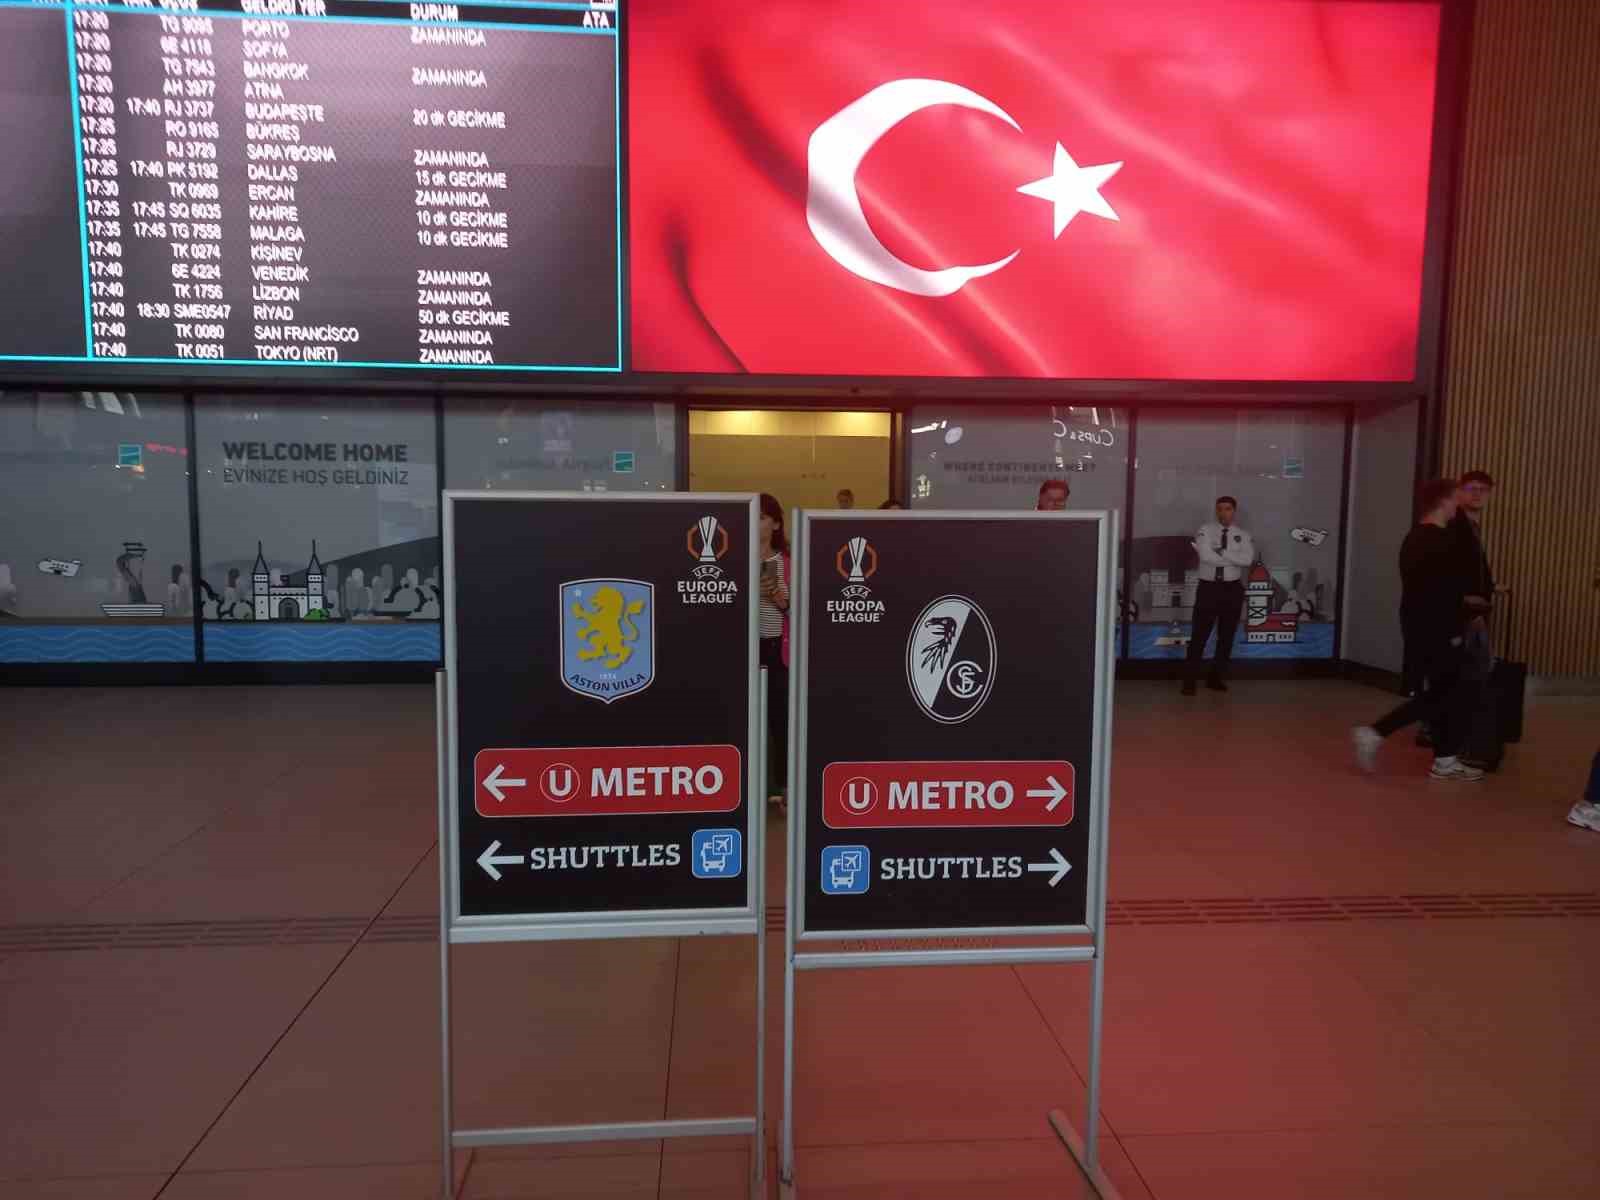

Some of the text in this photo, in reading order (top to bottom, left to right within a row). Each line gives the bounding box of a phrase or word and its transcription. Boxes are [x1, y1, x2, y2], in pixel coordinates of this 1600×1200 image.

[410, 3, 458, 22] DURUM
[583, 11, 610, 28] ATA
[241, 20, 290, 38] PORTO
[411, 27, 486, 46] ZAMANINDA
[242, 40, 289, 59] SOFYA
[243, 60, 310, 81] BANGKOK
[412, 67, 487, 88] ZAMANINDA
[163, 78, 183, 96] AH
[126, 98, 161, 116] 17:40
[164, 99, 182, 117] RJ
[184, 100, 214, 118] 3737
[413, 109, 428, 126] 20
[165, 120, 187, 137] RO
[246, 122, 300, 143] BÜKREŞ
[166, 141, 184, 158] RJ
[247, 144, 336, 162] SARAYBOSNA
[414, 149, 489, 167] ZAMANINDA
[130, 160, 163, 178] 17:40
[167, 161, 187, 178] PK
[248, 164, 298, 181] DALLAS
[416, 171, 430, 187] 15
[432, 172, 447, 188] dk
[85, 179, 119, 196] 17:30
[168, 182, 188, 199] TK
[248, 184, 294, 201] ERCAN
[415, 190, 489, 207] ZAMANINDA
[86, 200, 120, 217] 17:35
[132, 202, 165, 218] 17:45
[169, 202, 190, 219] SQ
[249, 203, 298, 222] KAHİRE
[417, 210, 430, 226] 10
[433, 211, 447, 227] dk
[88, 220, 121, 237] 17:35
[133, 222, 167, 238] 17:45
[170, 223, 190, 239] TG
[250, 226, 305, 242] MALAGA
[417, 230, 430, 246] 10
[433, 231, 448, 247] dk
[89, 241, 122, 257] 17:40
[171, 243, 190, 259] TK
[191, 244, 221, 259] 0274
[90, 261, 123, 278] 17:40
[191, 264, 221, 279] 4224
[252, 264, 310, 281] VENEDİK
[417, 270, 492, 287] ZAMANINDA
[91, 282, 492, 307] 17:40 TK 1756 LİZBON ZAMANINDA
[92, 302, 125, 318] 17:40
[137, 303, 170, 319] 18:30
[253, 303, 294, 320] RİYAD
[419, 310, 433, 325] 50
[436, 311, 450, 326] dk
[93, 322, 493, 345] 17:40 TK 0080 SAN FRANCİSCO ZAMANINDA
[94, 342, 494, 364] 17:40 TK 0051 TOKYO (NRT) ZAMANINDA
[223, 442, 407, 463] WELCOME HOME
[292, 468, 328, 487] HOŞ
[694, 567, 721, 578] UEFA
[677, 580, 738, 593] EUROPA
[843, 586, 870, 598] UEFA
[682, 593, 733, 604] LEAGUE
[827, 600, 886, 612] EUROPA
[831, 612, 880, 623] LEAGUE
[569, 672, 647, 692] ASTON VILLA
[549, 764, 724, 798] U METRO
[848, 780, 1015, 811] U METRO
[530, 844, 682, 871] SHUTTLES
[880, 856, 1024, 880] SHUTTLES
